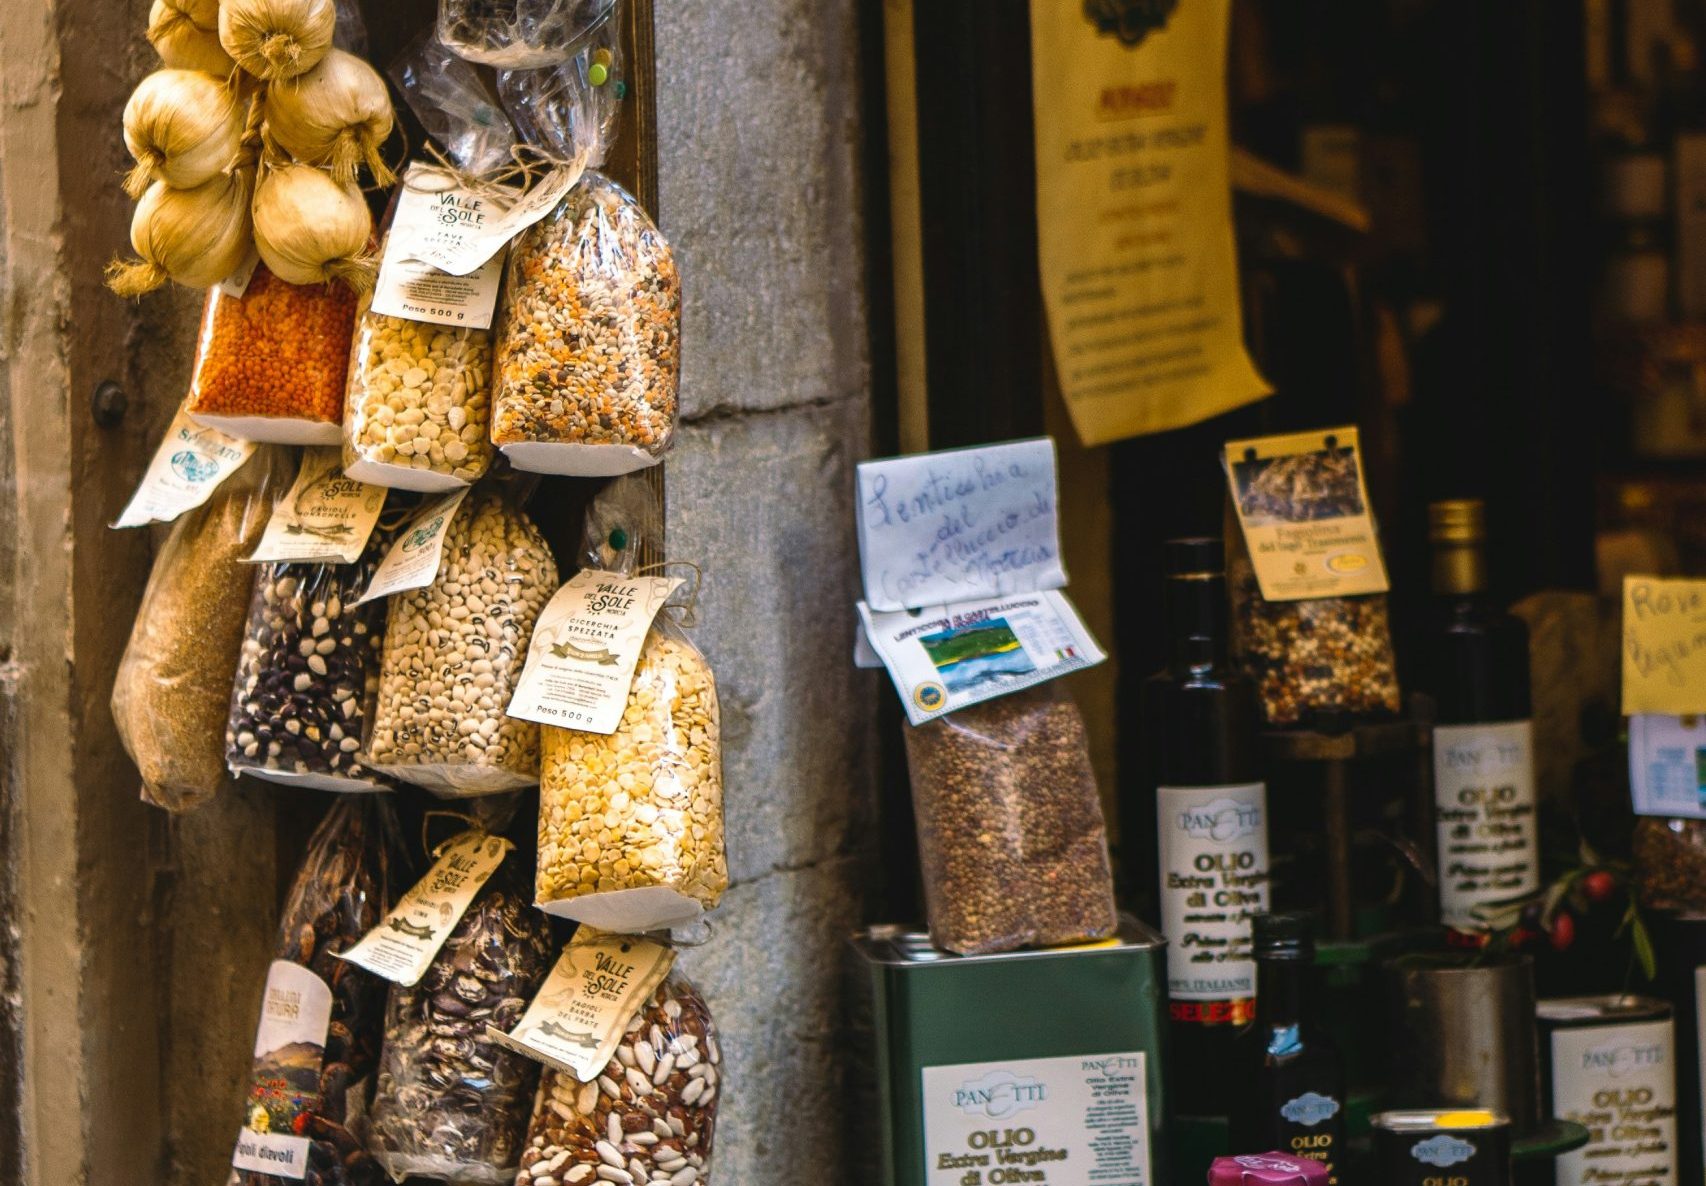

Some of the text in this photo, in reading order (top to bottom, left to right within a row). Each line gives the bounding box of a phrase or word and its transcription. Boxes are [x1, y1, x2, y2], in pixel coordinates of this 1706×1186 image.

[435, 190, 483, 211] VALLE
[442, 208, 486, 224] SOLE
[402, 303, 464, 320] Peso 500 g
[325, 480, 363, 498] SOLE
[595, 583, 638, 598] VALLE
[584, 593, 635, 612] DEL SOLE
[567, 625, 615, 640] SPEZZATA
[569, 618, 618, 631] CICERCHIA
[537, 705, 558, 716] Peso
[561, 709, 583, 721] 500
[448, 853, 478, 874] VALLE
[1194, 851, 1255, 872] OLIO
[433, 871, 469, 891] SOLE
[1167, 872, 1216, 889] Extra
[1186, 891, 1207, 908] di
[595, 952, 635, 980] VALLE
[582, 969, 629, 996] DEL SOLE
[572, 1000, 603, 1013] FAGIOLI
[1593, 1088, 1653, 1109] OLIO
[966, 1127, 1036, 1149] OLIO
[1290, 1134, 1333, 1150] OLIO
[938, 1146, 1069, 1169] Extra Vergine
[961, 1167, 1046, 1186] di Oliva
